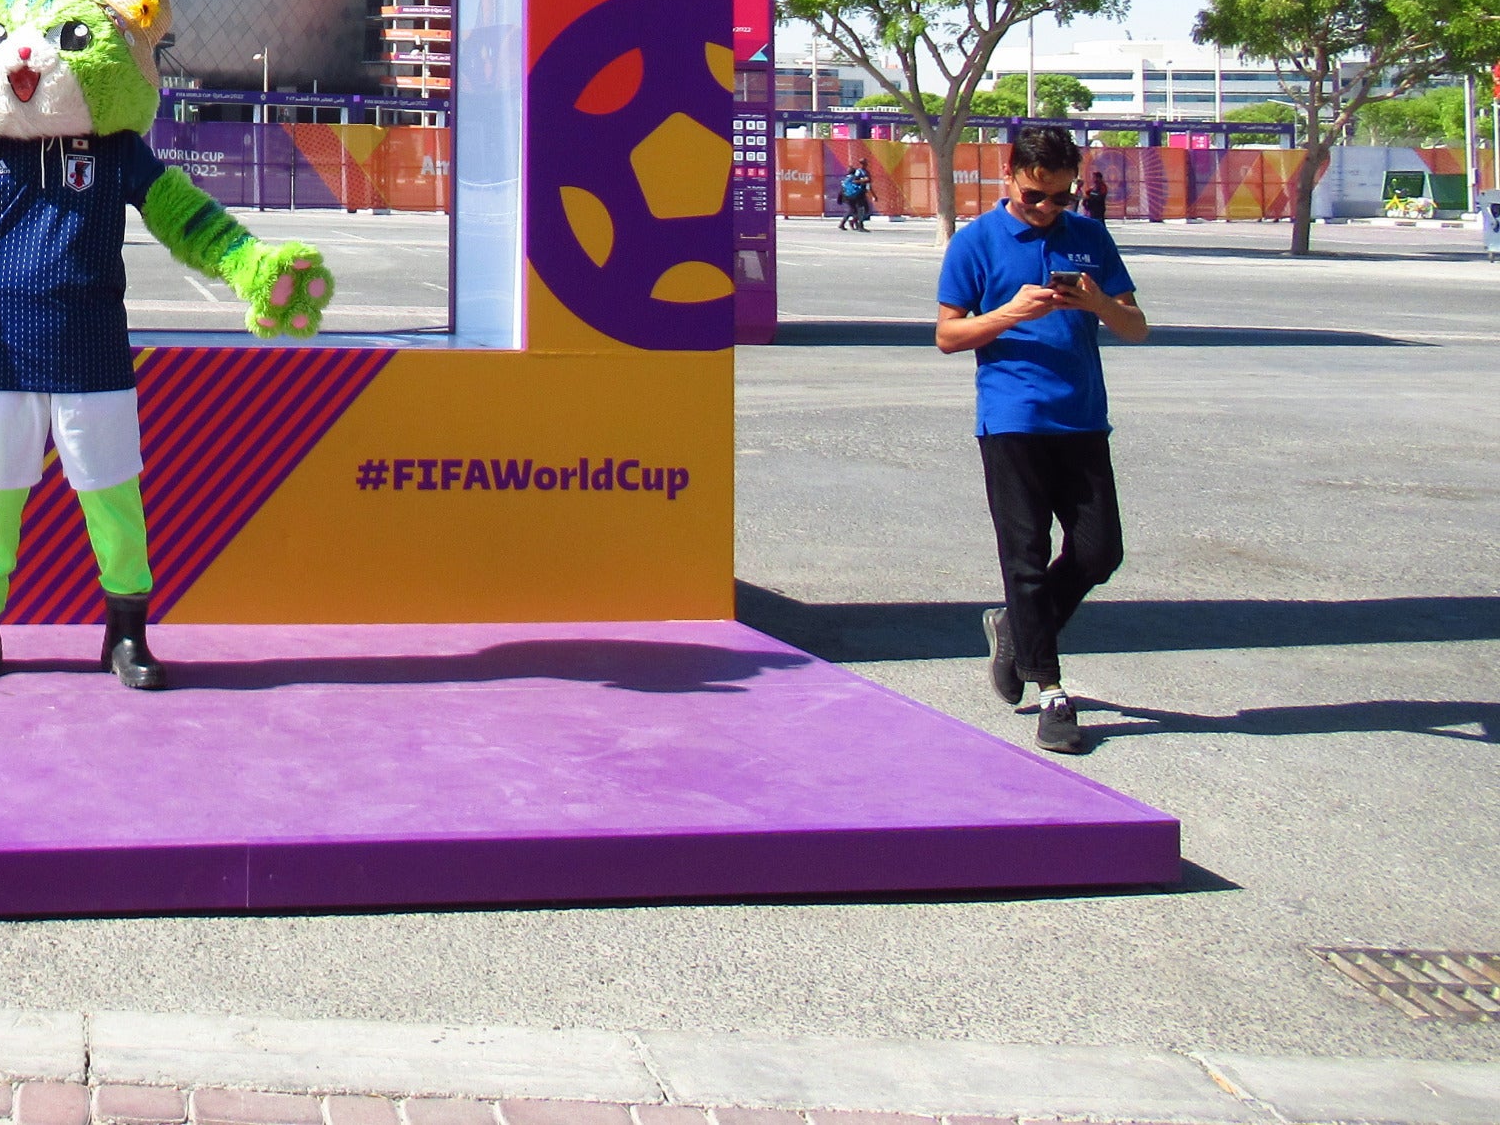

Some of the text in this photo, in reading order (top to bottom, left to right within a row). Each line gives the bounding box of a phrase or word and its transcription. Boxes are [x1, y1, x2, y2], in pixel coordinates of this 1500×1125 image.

[157, 149, 224, 162] WORLD CUP
[355, 456, 690, 501] #FIFAWorldCup
